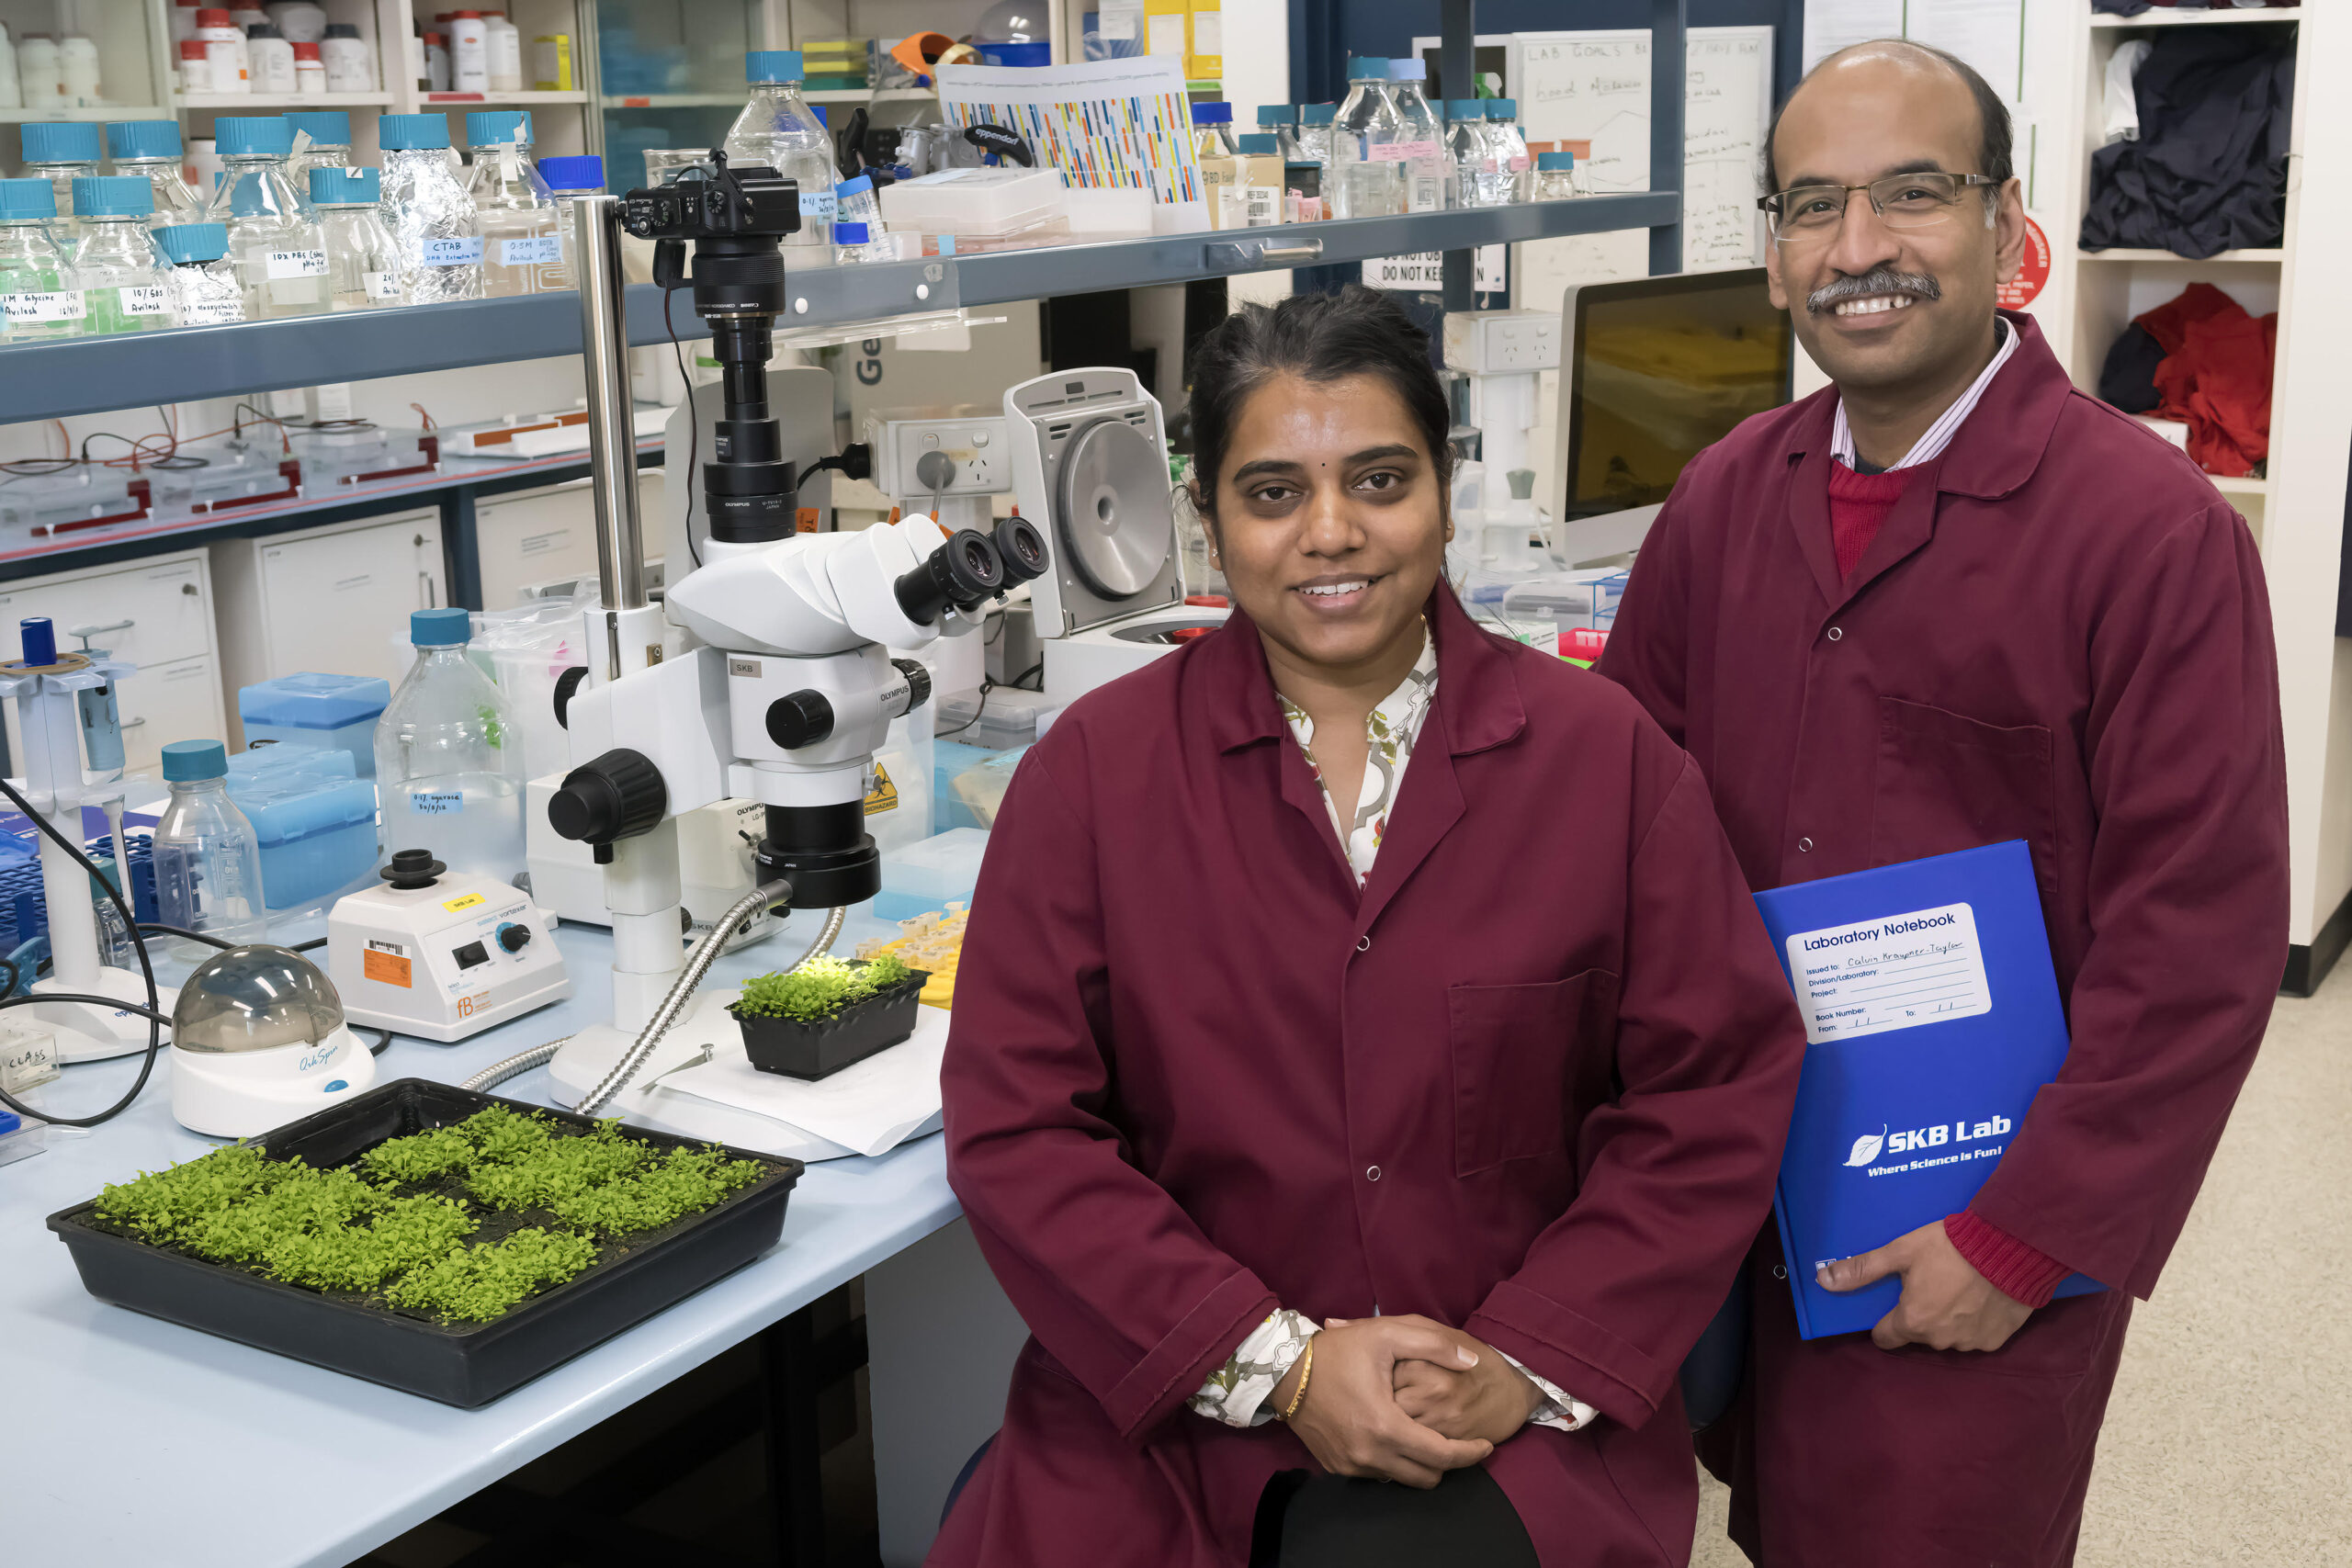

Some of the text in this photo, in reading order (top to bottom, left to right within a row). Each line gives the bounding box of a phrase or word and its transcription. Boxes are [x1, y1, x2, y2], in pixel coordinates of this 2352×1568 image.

[975, 128, 1018, 146] eppendorf
[433, 243, 462, 252] CTAB
[1383, 265, 1443, 281] DO NOT KEE
[25, 294, 54, 306] Glycine
[736, 664, 753, 672] SKB
[880, 684, 910, 703] OLYMPUS
[737, 802, 764, 816] OLYMPU
[865, 800, 898, 813] BIOHAZARD
[499, 904, 527, 919] vortexer
[691, 923, 713, 931] SKB
[1804, 913, 1956, 952] Laboratory Notebook
[1848, 955, 1879, 967] Calvin
[1806, 964, 1840, 976] Issued to:
[1808, 969, 1880, 987] Division/Laboratory:
[1811, 988, 1838, 999] Project:
[1815, 1007, 1867, 1021] Book Number:
[1906, 1010, 1917, 1018] To:
[1818, 1024, 1838, 1034] From:
[1888, 1114, 2011, 1155] SKB Lab
[1868, 1145, 2002, 1178] Where Science is Fun!
